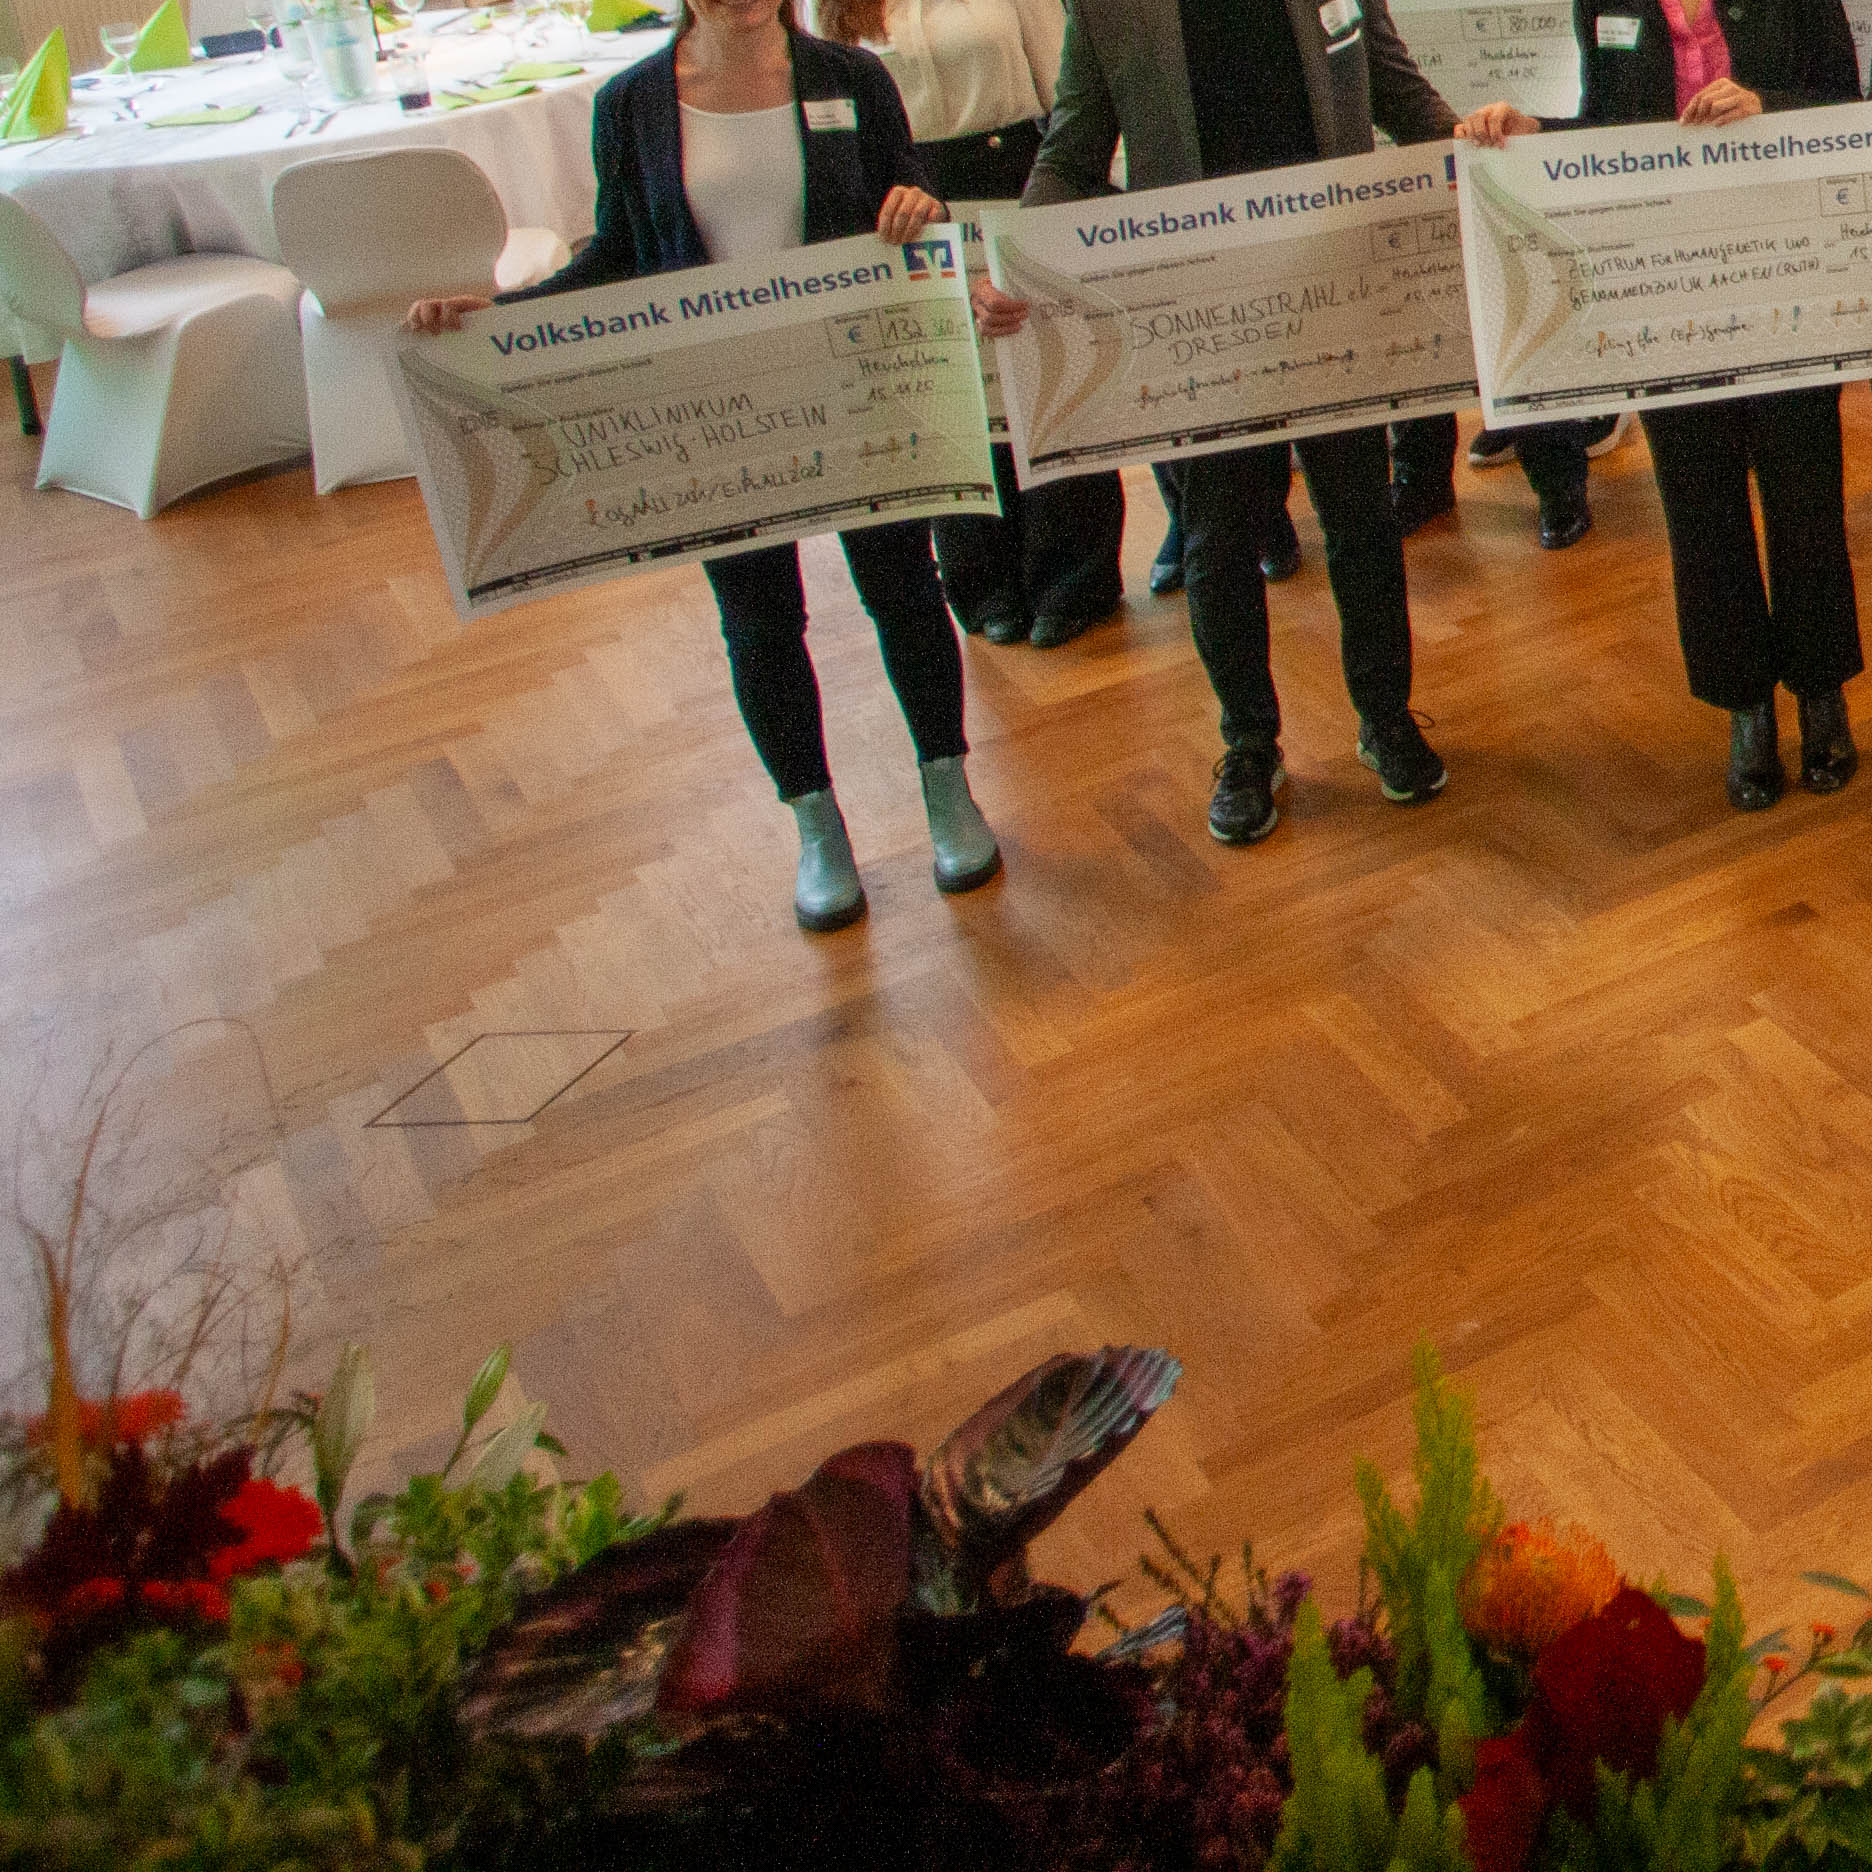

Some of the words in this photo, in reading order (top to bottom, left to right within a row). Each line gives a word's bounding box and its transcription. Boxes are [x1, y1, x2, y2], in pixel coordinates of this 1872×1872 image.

[1543, 145, 1691, 180] Volksbank
[1077, 203, 1235, 246] Volksbank
[1246, 173, 1432, 219] Mittelhessen
[1836, 187, 1848, 205] €
[1387, 230, 1401, 249] €
[1709, 267, 1772, 286] AACHEN
[490, 302, 669, 354] Volksbank
[679, 263, 891, 318] Mittelhessen
[1129, 281, 1341, 349] SONNENSTRAHL
[847, 324, 864, 343] €
[1167, 318, 1305, 366] DRESDEN
[561, 392, 753, 447] UNIKLINIKUM
